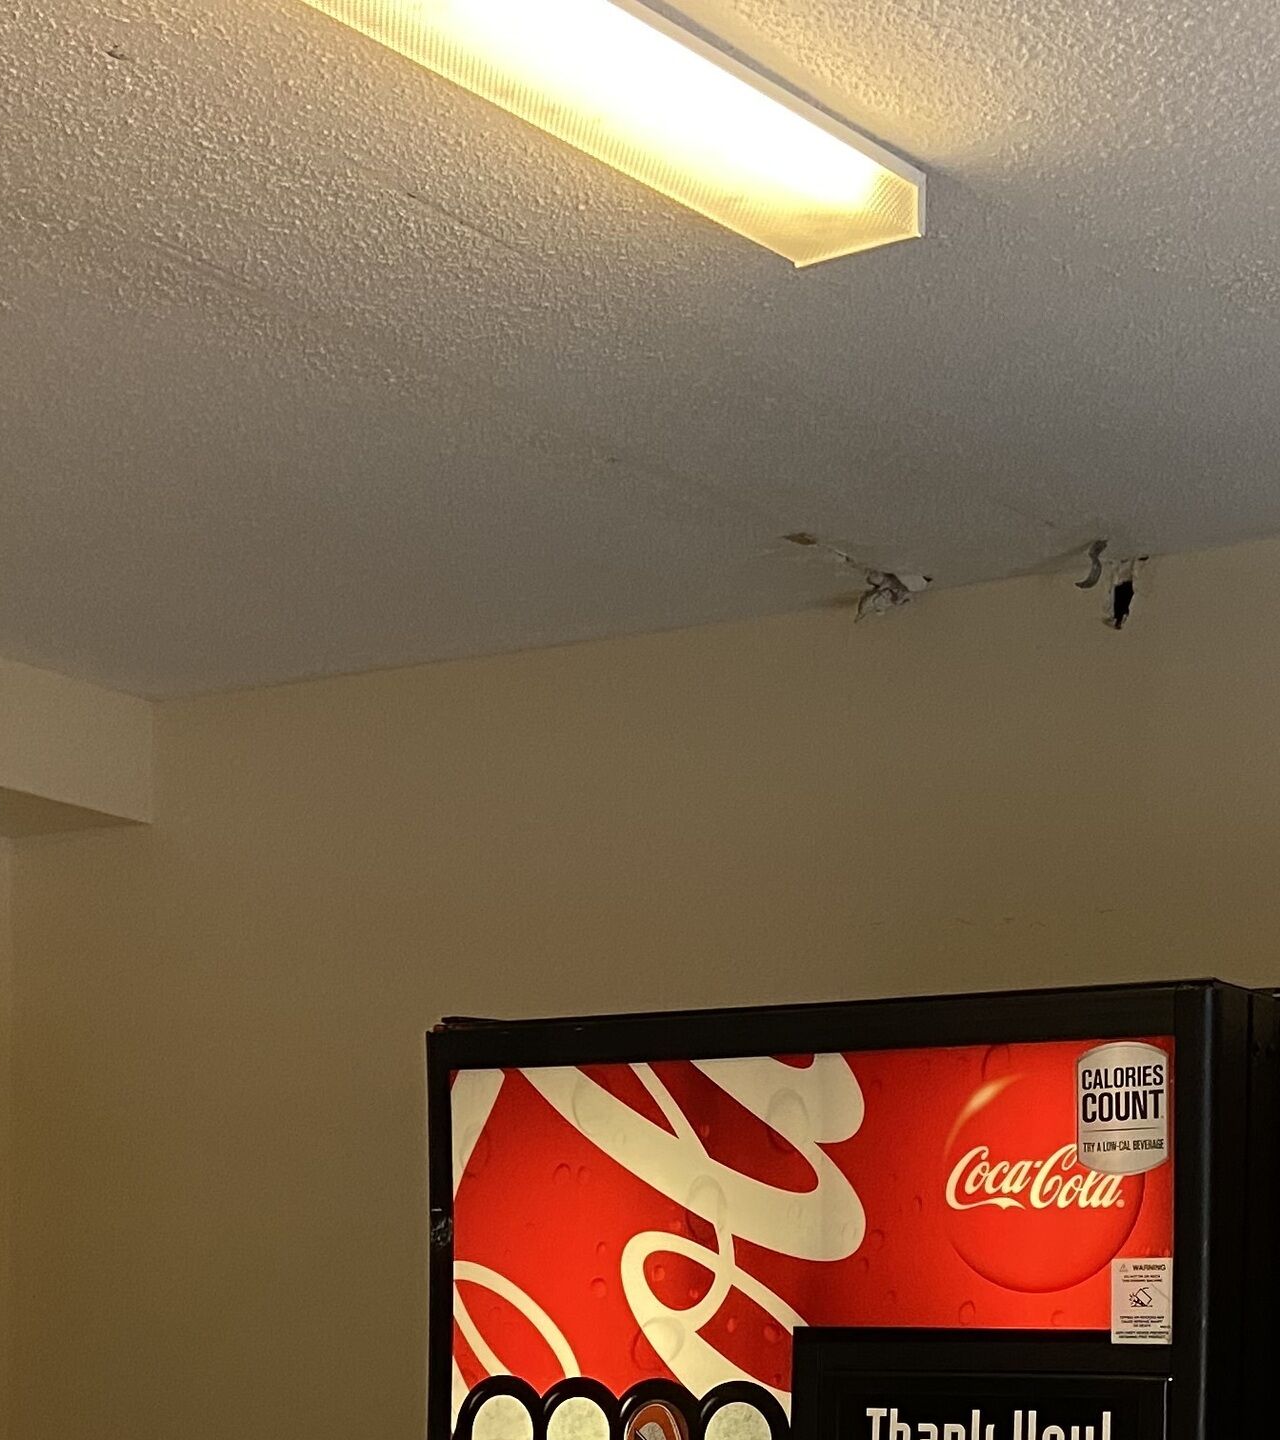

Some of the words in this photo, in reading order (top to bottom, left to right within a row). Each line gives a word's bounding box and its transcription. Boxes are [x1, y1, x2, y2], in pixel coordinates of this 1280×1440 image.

[1082, 1064, 1164, 1091] CALORIES
[1082, 1089, 1164, 1123] COUNT
[1083, 1142, 1095, 1153] TRY
[1096, 1142, 1102, 1152] A
[1103, 1141, 1131, 1152] LOW-CAL
[1133, 1139, 1164, 1151] BEVERAGE
[945, 1144, 1122, 1210] Coca-Cola
